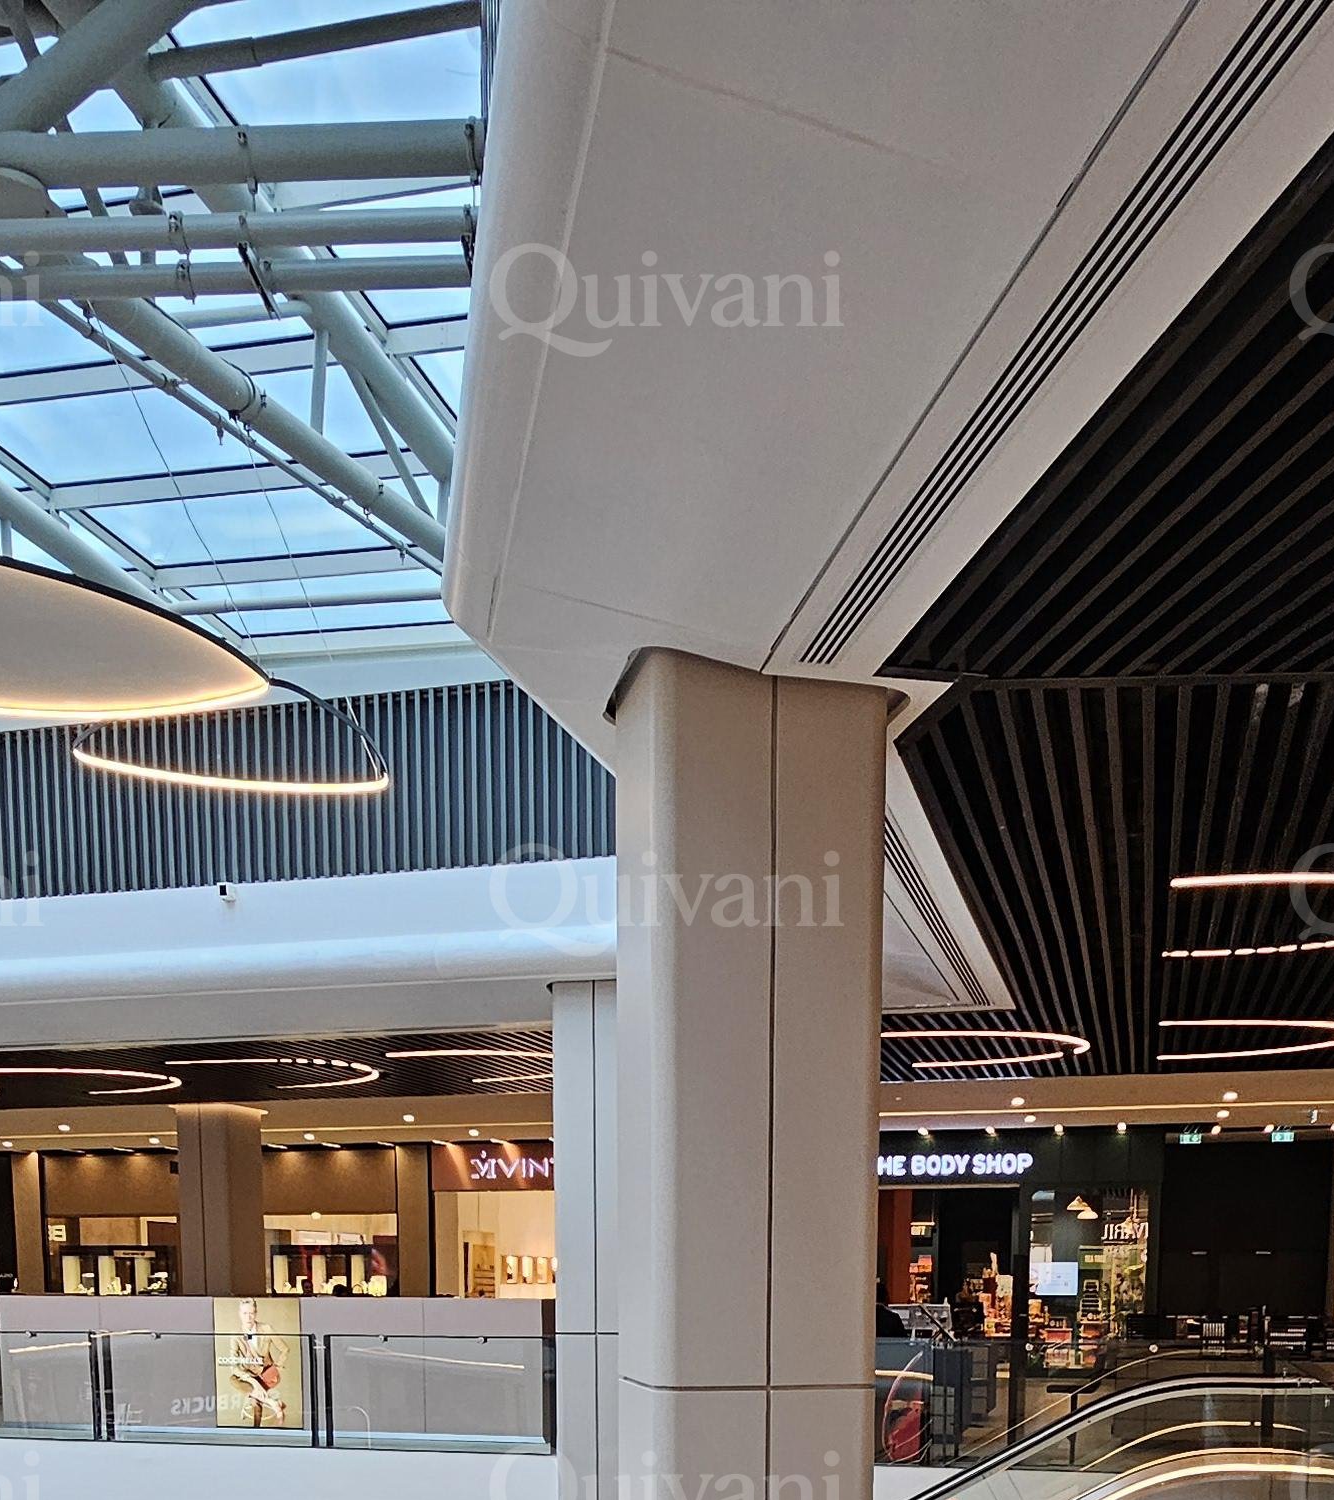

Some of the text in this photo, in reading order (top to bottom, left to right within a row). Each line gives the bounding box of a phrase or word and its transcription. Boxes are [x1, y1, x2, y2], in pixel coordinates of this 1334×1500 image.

[877, 1152, 1034, 1177] HE BODY SHOP
